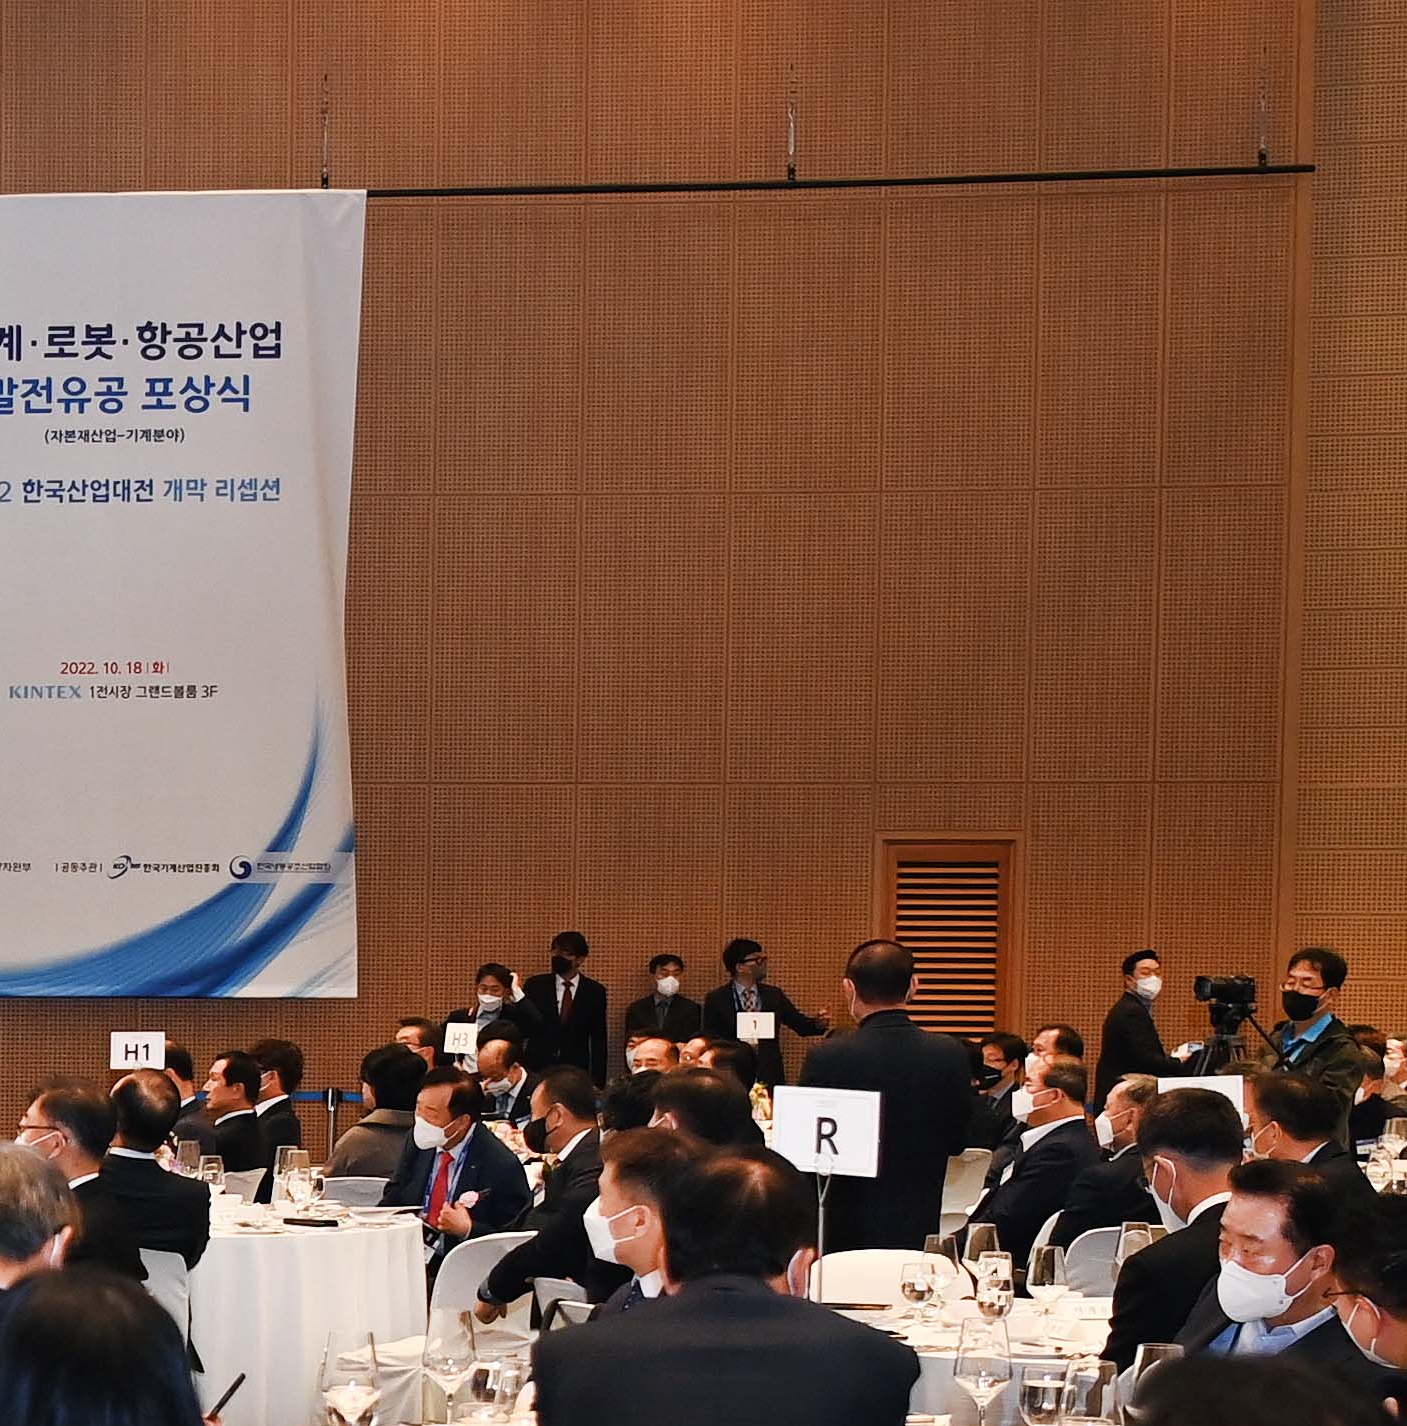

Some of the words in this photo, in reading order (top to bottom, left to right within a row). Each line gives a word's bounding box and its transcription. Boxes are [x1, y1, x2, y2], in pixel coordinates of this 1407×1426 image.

[141, 375, 249, 414] 포상식
[45, 428, 184, 444] (자본재산업-기계분야)
[22, 478, 153, 504] 한국산업대전
[163, 478, 209, 502] 개막
[214, 478, 281, 503] 리셉션
[9, 685, 81, 699] KINTEX
[90, 685, 131, 700] 1전시장
[136, 685, 197, 699] 그랜드볼룸
[201, 685, 217, 699] 3F
[124, 1043, 150, 1061] H1
[815, 1116, 839, 1155] R
